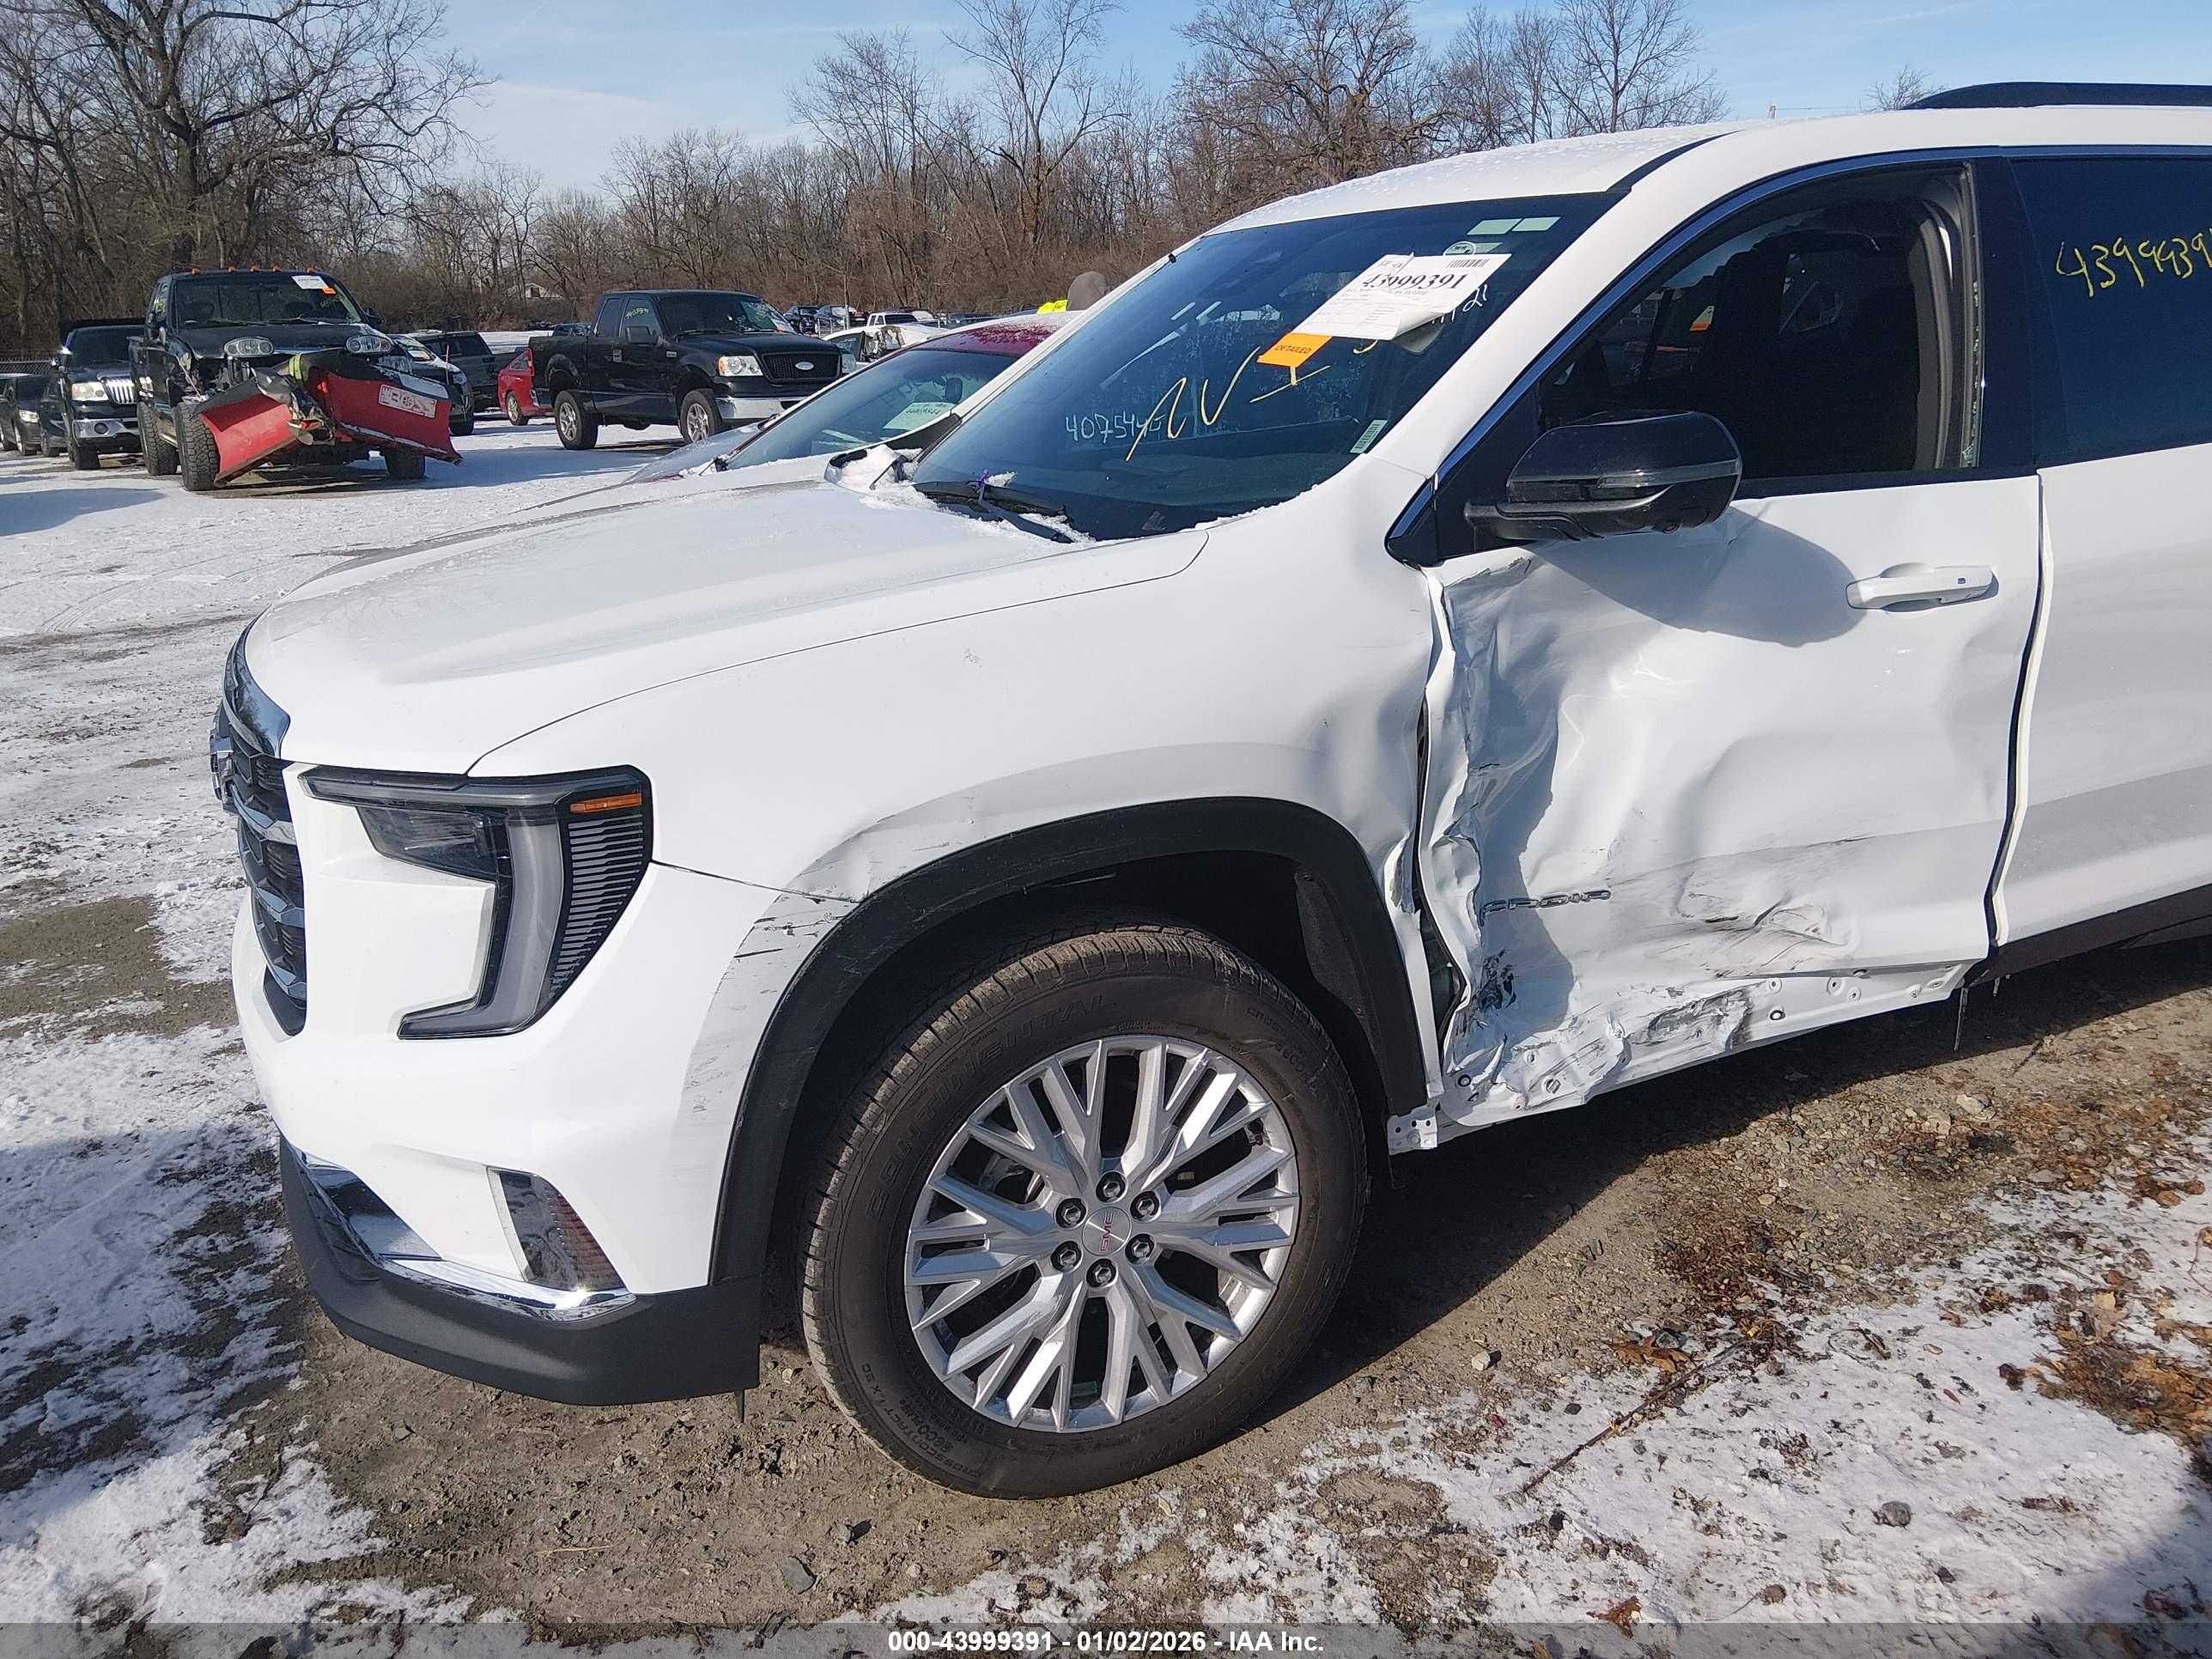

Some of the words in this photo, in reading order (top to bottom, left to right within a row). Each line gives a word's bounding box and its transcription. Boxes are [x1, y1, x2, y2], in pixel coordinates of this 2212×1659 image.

[1274, 344, 1312, 355] DETAILED
[866, 994, 1118, 1223] CONTINENTAL
[1099, 1211, 1115, 1252] GMC
